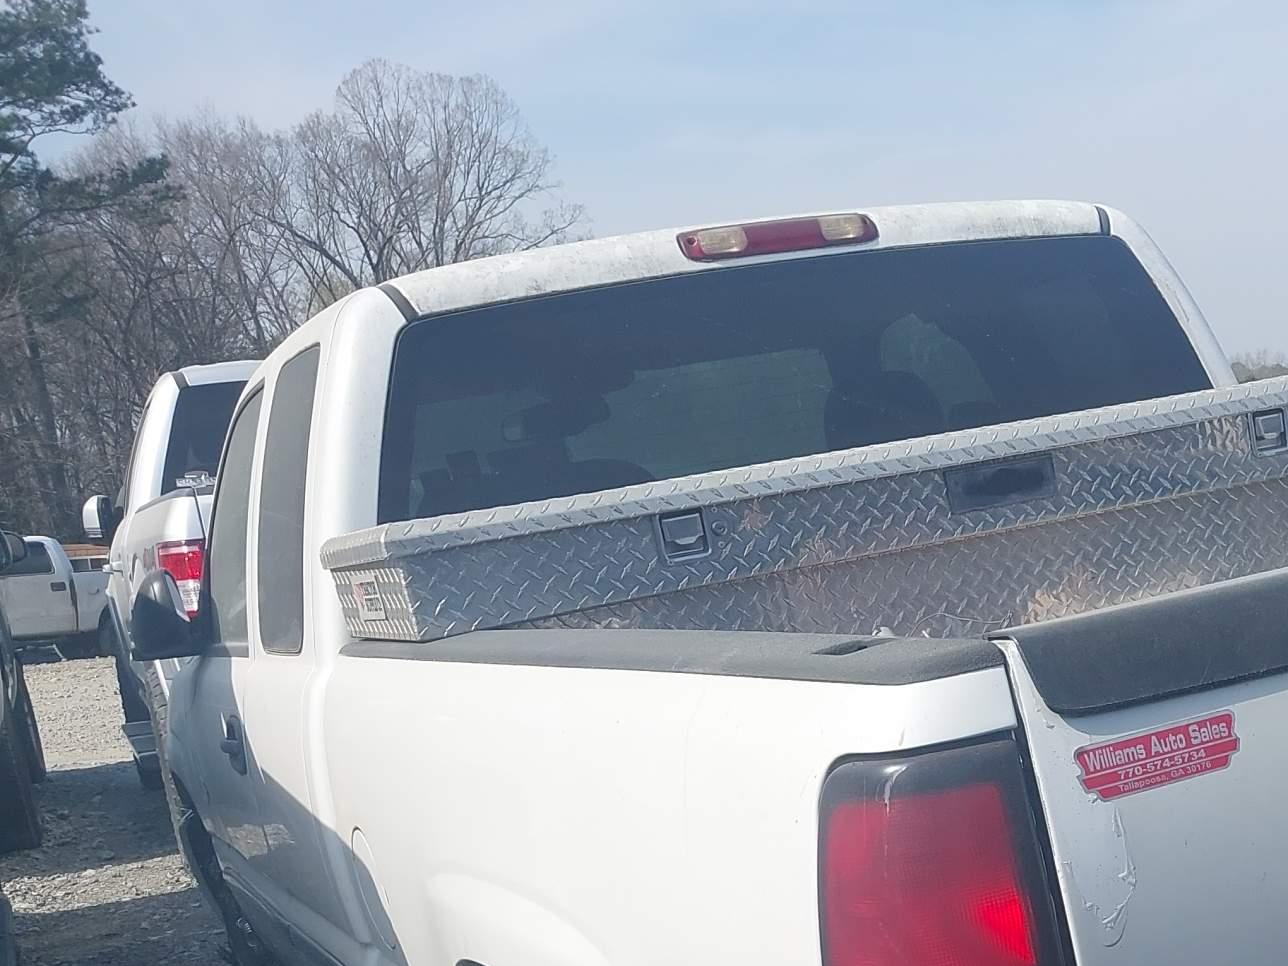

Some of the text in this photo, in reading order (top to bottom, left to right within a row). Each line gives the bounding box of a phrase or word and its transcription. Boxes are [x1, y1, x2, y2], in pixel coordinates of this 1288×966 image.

[1084, 721, 1229, 772] Williams Auto Sales
[1118, 749, 1207, 780] 770-574-5734
[1118, 775, 1169, 792] Tallapoosa,
[1170, 769, 1186, 778] GA
